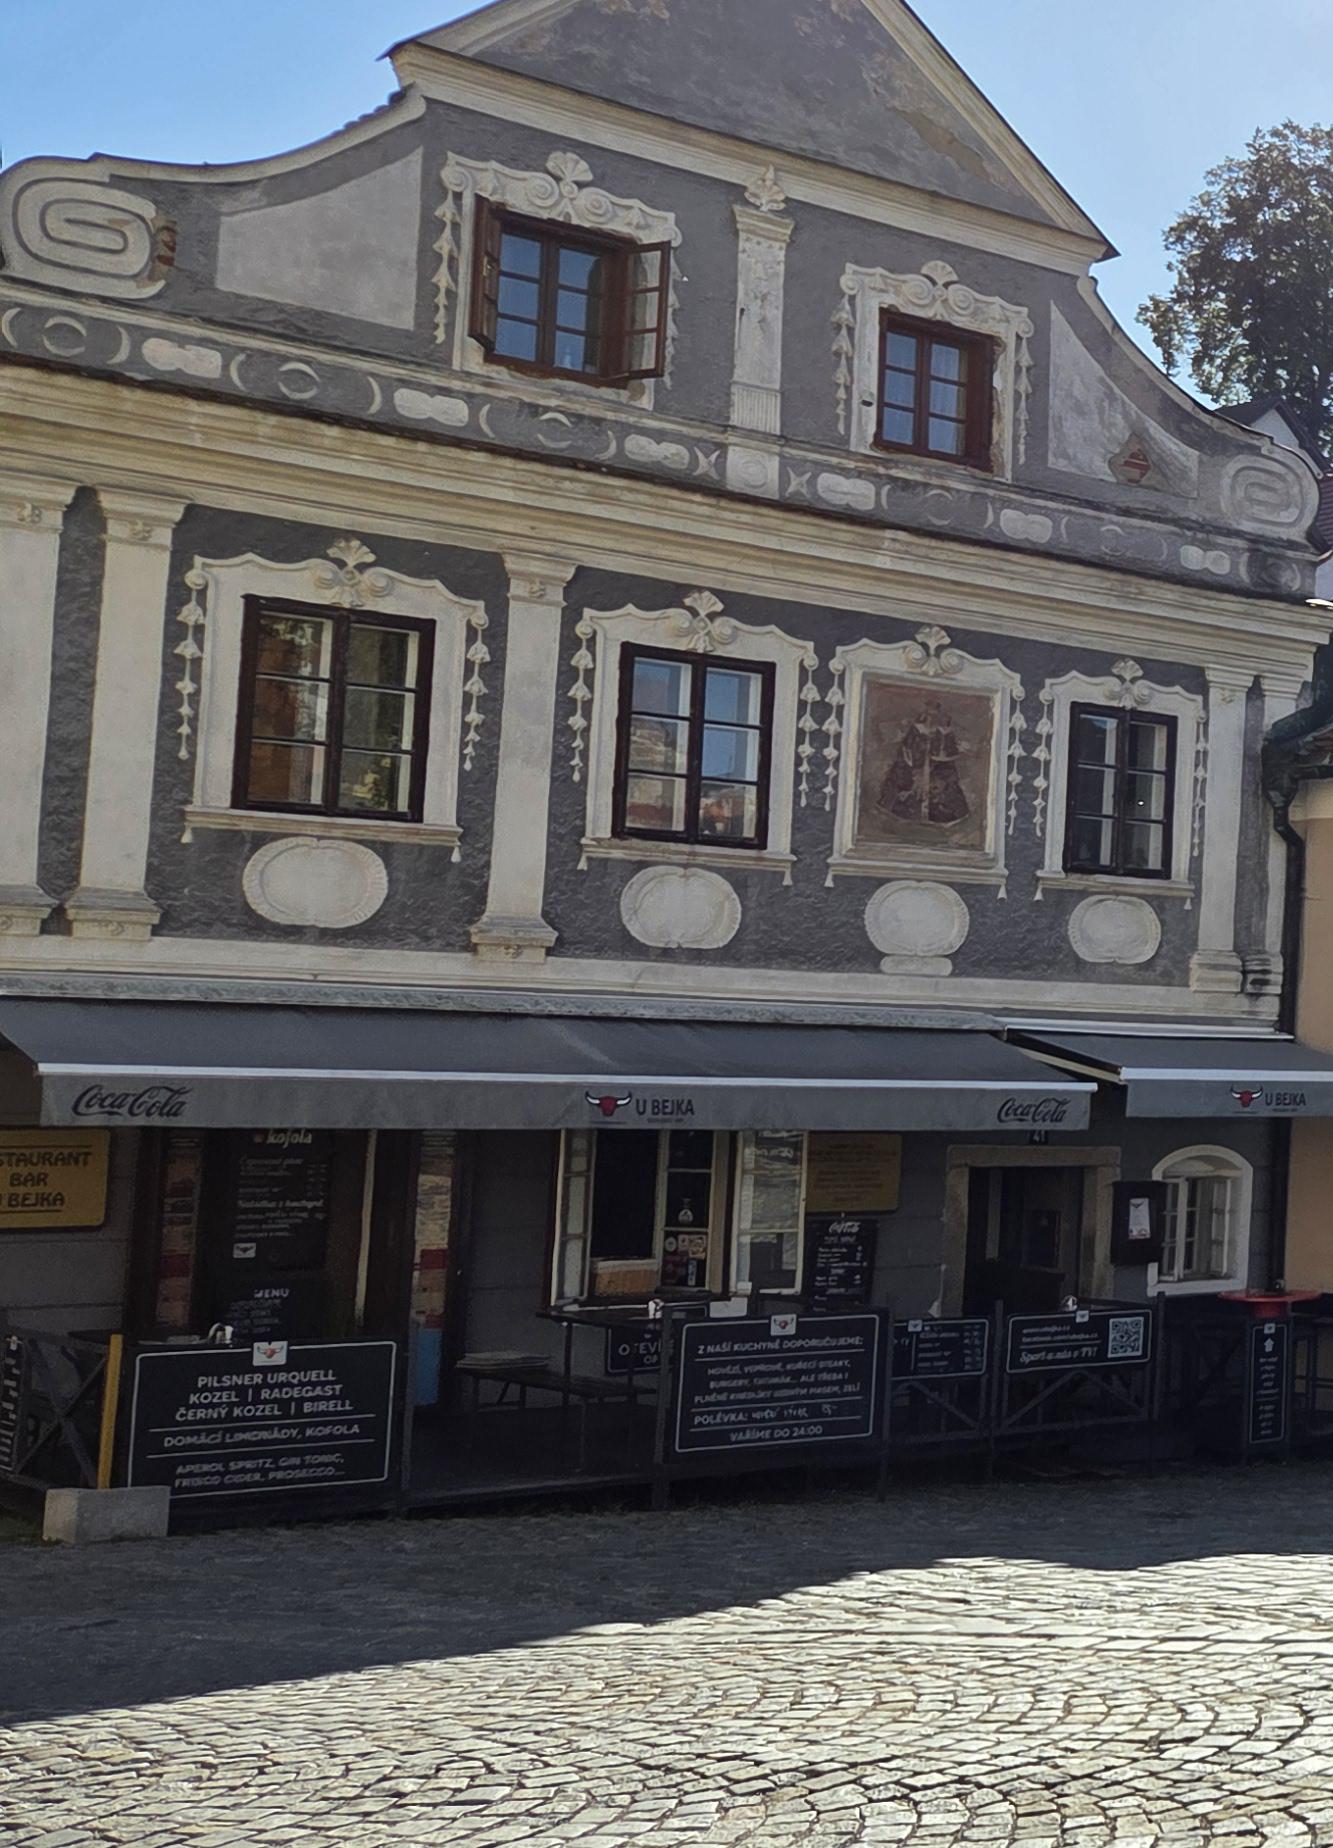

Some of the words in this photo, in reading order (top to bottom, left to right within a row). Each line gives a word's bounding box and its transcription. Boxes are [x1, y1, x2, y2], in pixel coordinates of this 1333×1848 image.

[72, 1084, 192, 1117] Coca-Cola
[635, 1099, 647, 1116] U
[651, 1098, 695, 1116] BEJKA
[1265, 1092, 1273, 1106] U
[1275, 1092, 1306, 1106] BEJKA
[997, 1096, 1071, 1123] Coca-Cola
[9, 1172, 49, 1187] BAR
[7, 1191, 65, 1207] BEJKA
[698, 1345, 705, 1354] Z
[706, 1341, 731, 1353] NAŠÍ
[197, 1373, 263, 1388] PILSNER
[267, 1369, 336, 1385] URQUELL
[189, 1391, 239, 1405] KOZEL
[261, 1384, 343, 1400] RADEGAST
[175, 1406, 229, 1422] ČERNÝ
[233, 1403, 282, 1418] KOZEL
[303, 1400, 354, 1413] BIRELL
[773, 1427, 790, 1438] DO
